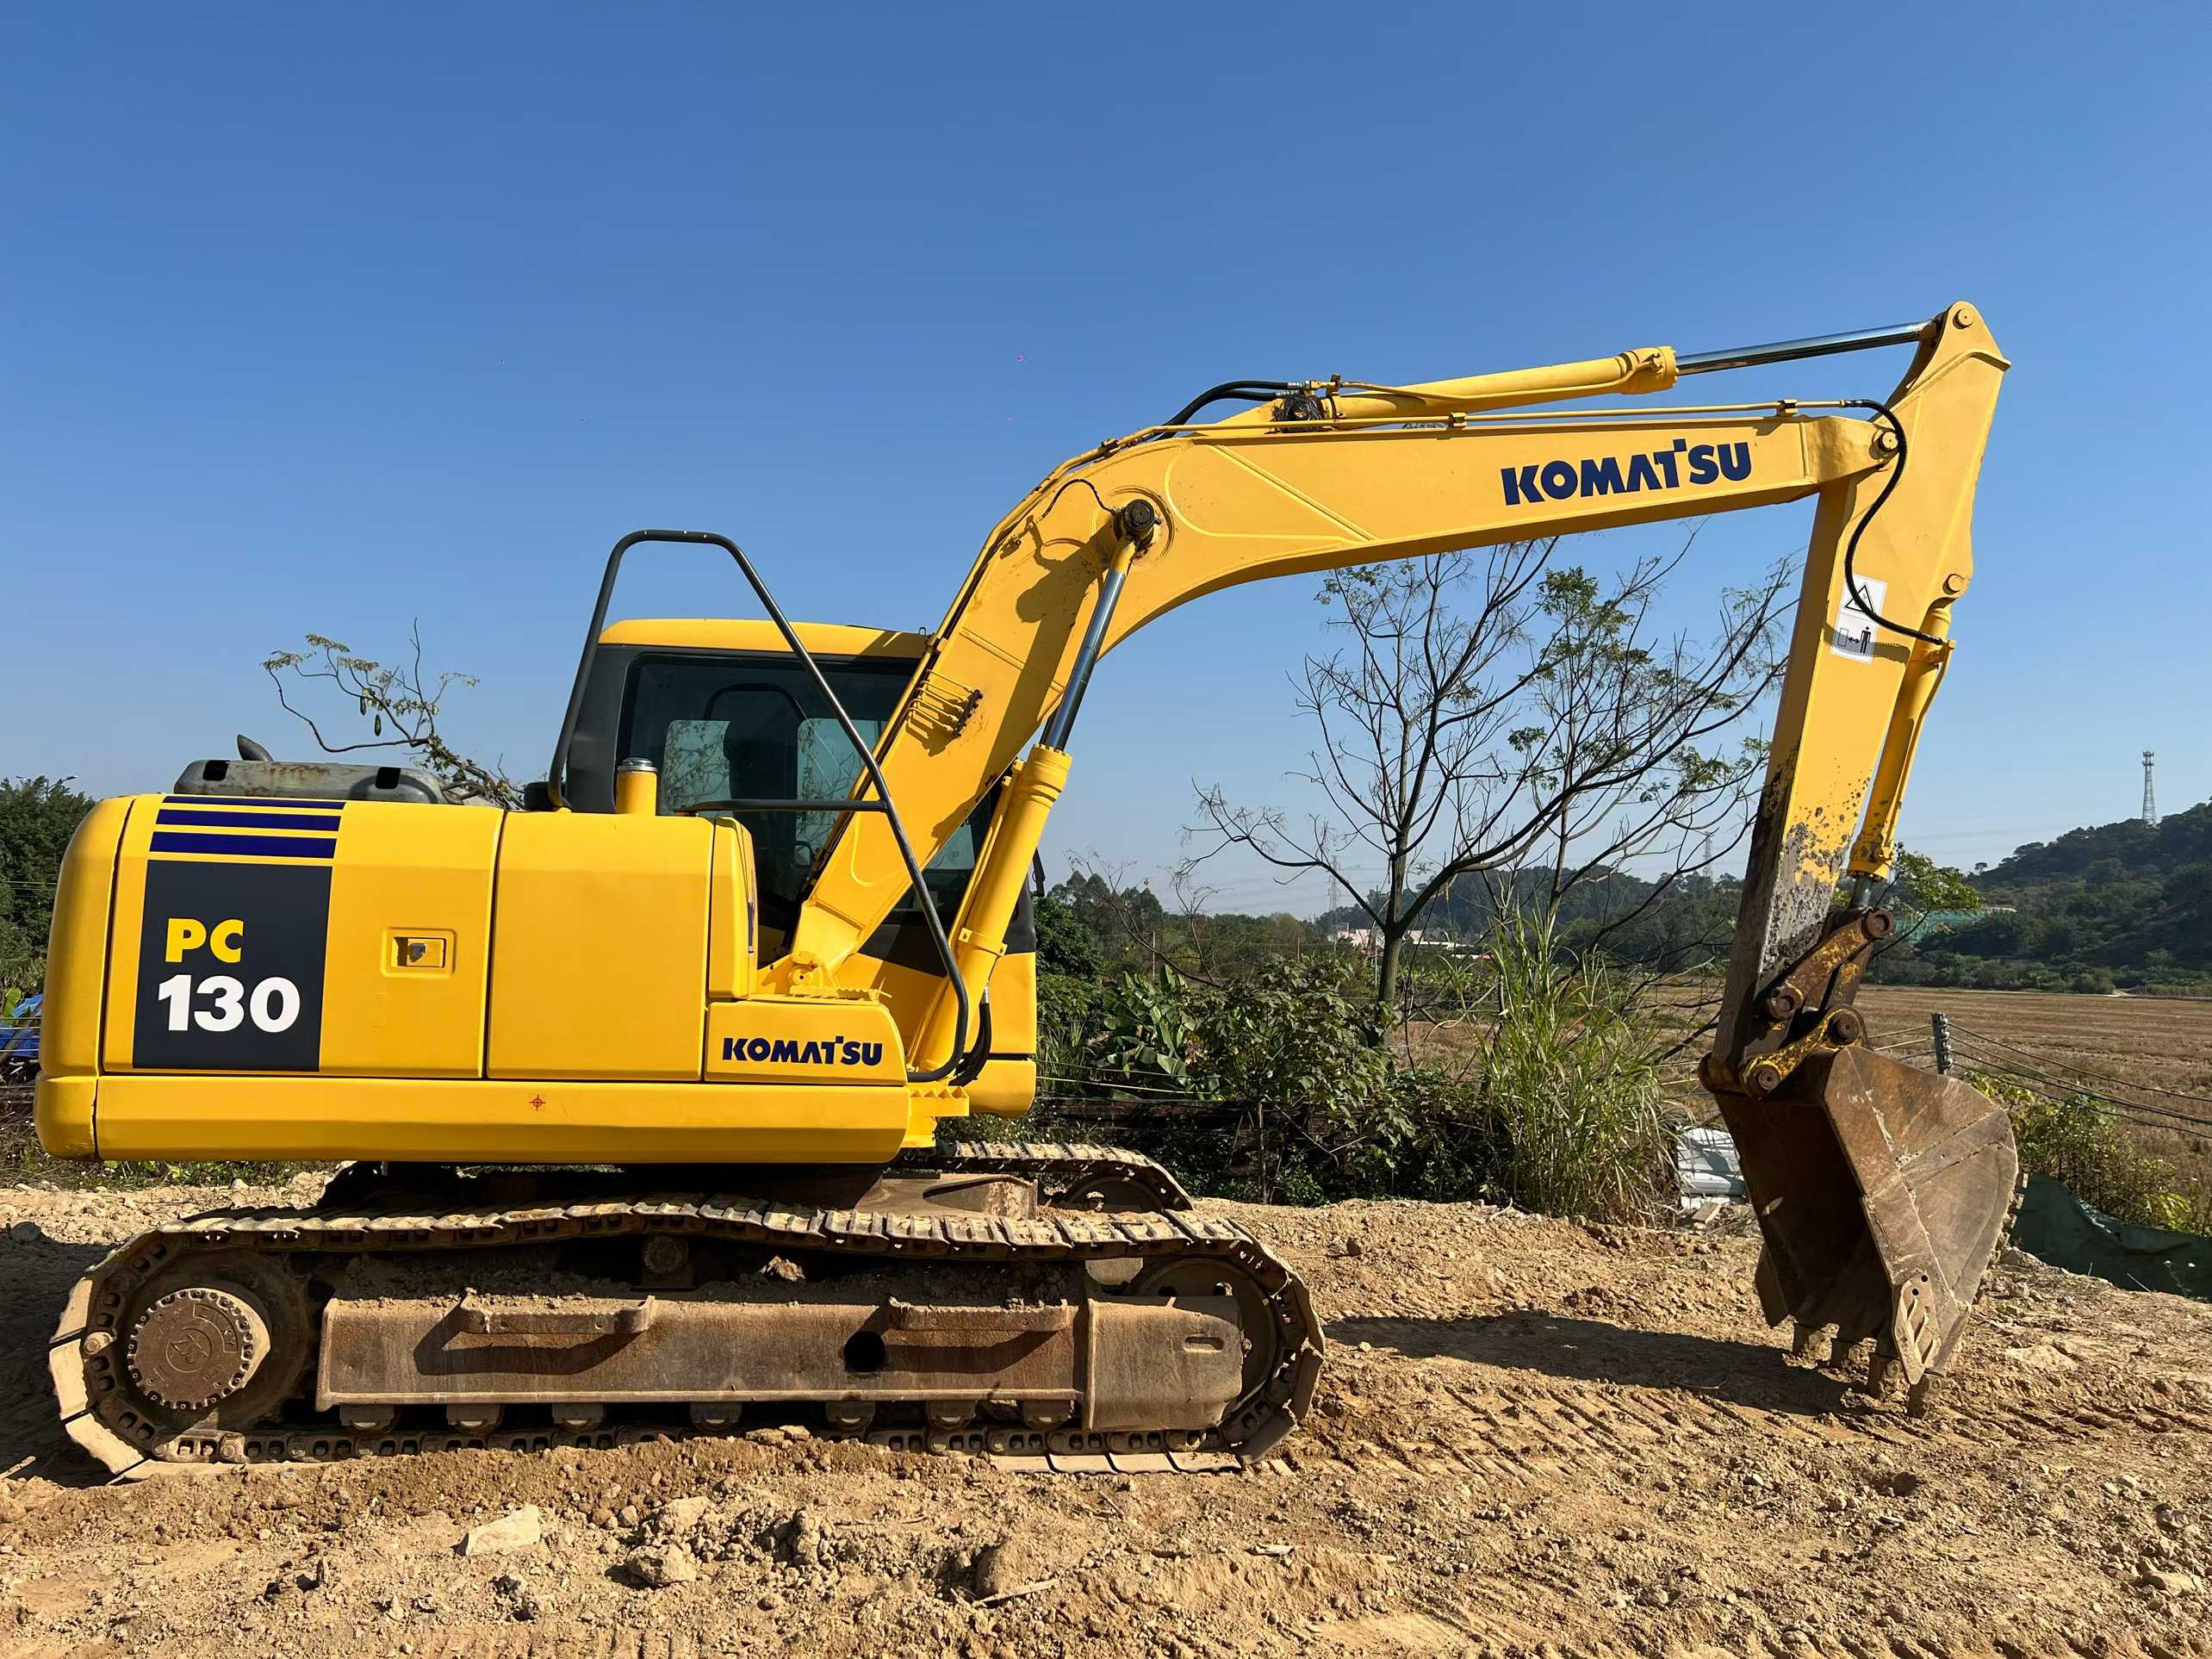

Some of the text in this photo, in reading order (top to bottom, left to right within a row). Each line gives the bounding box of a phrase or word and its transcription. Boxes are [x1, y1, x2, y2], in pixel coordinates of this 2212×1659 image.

[1501, 438, 1751, 506] KOMATSU
[165, 918, 244, 963] PC
[158, 975, 300, 1033] 130
[723, 1035, 882, 1066] KOMATSU
